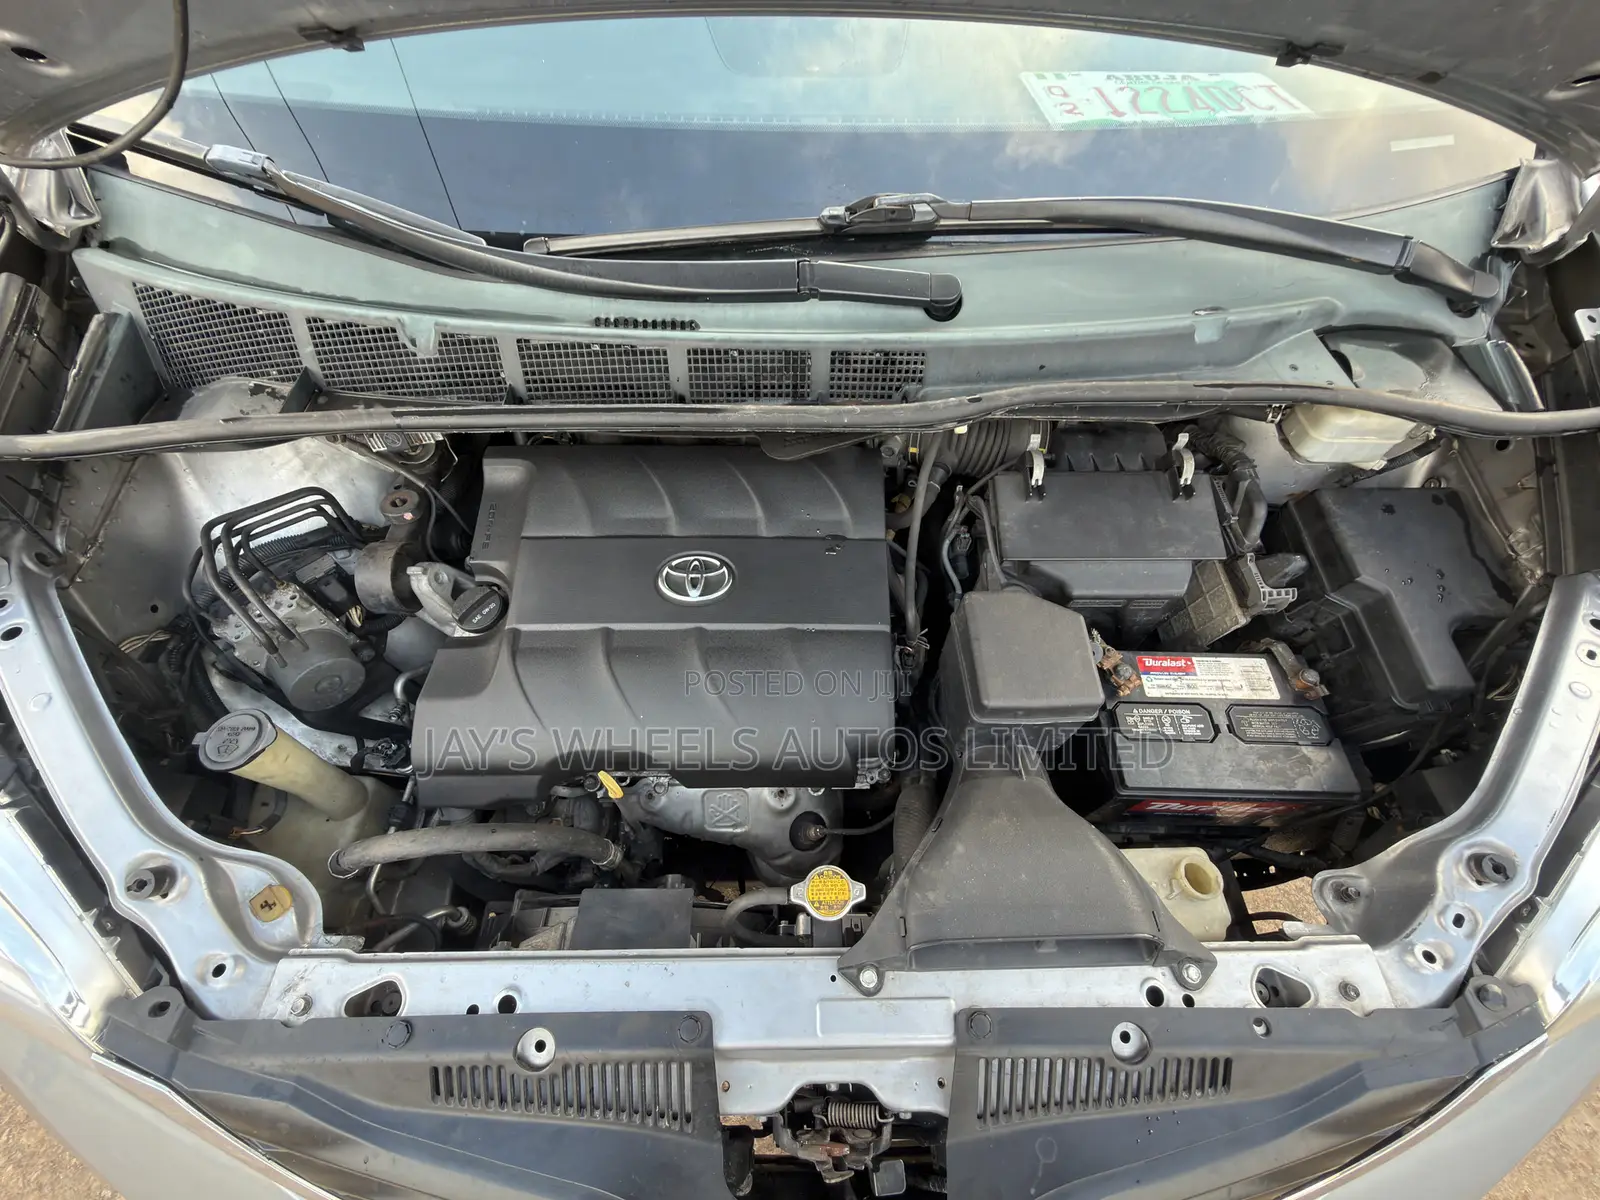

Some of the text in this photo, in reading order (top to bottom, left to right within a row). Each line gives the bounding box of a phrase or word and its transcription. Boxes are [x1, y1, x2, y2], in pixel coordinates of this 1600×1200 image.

[472, 602, 497, 624] SAE 0W-20
[1142, 658, 1187, 667] Duralast
